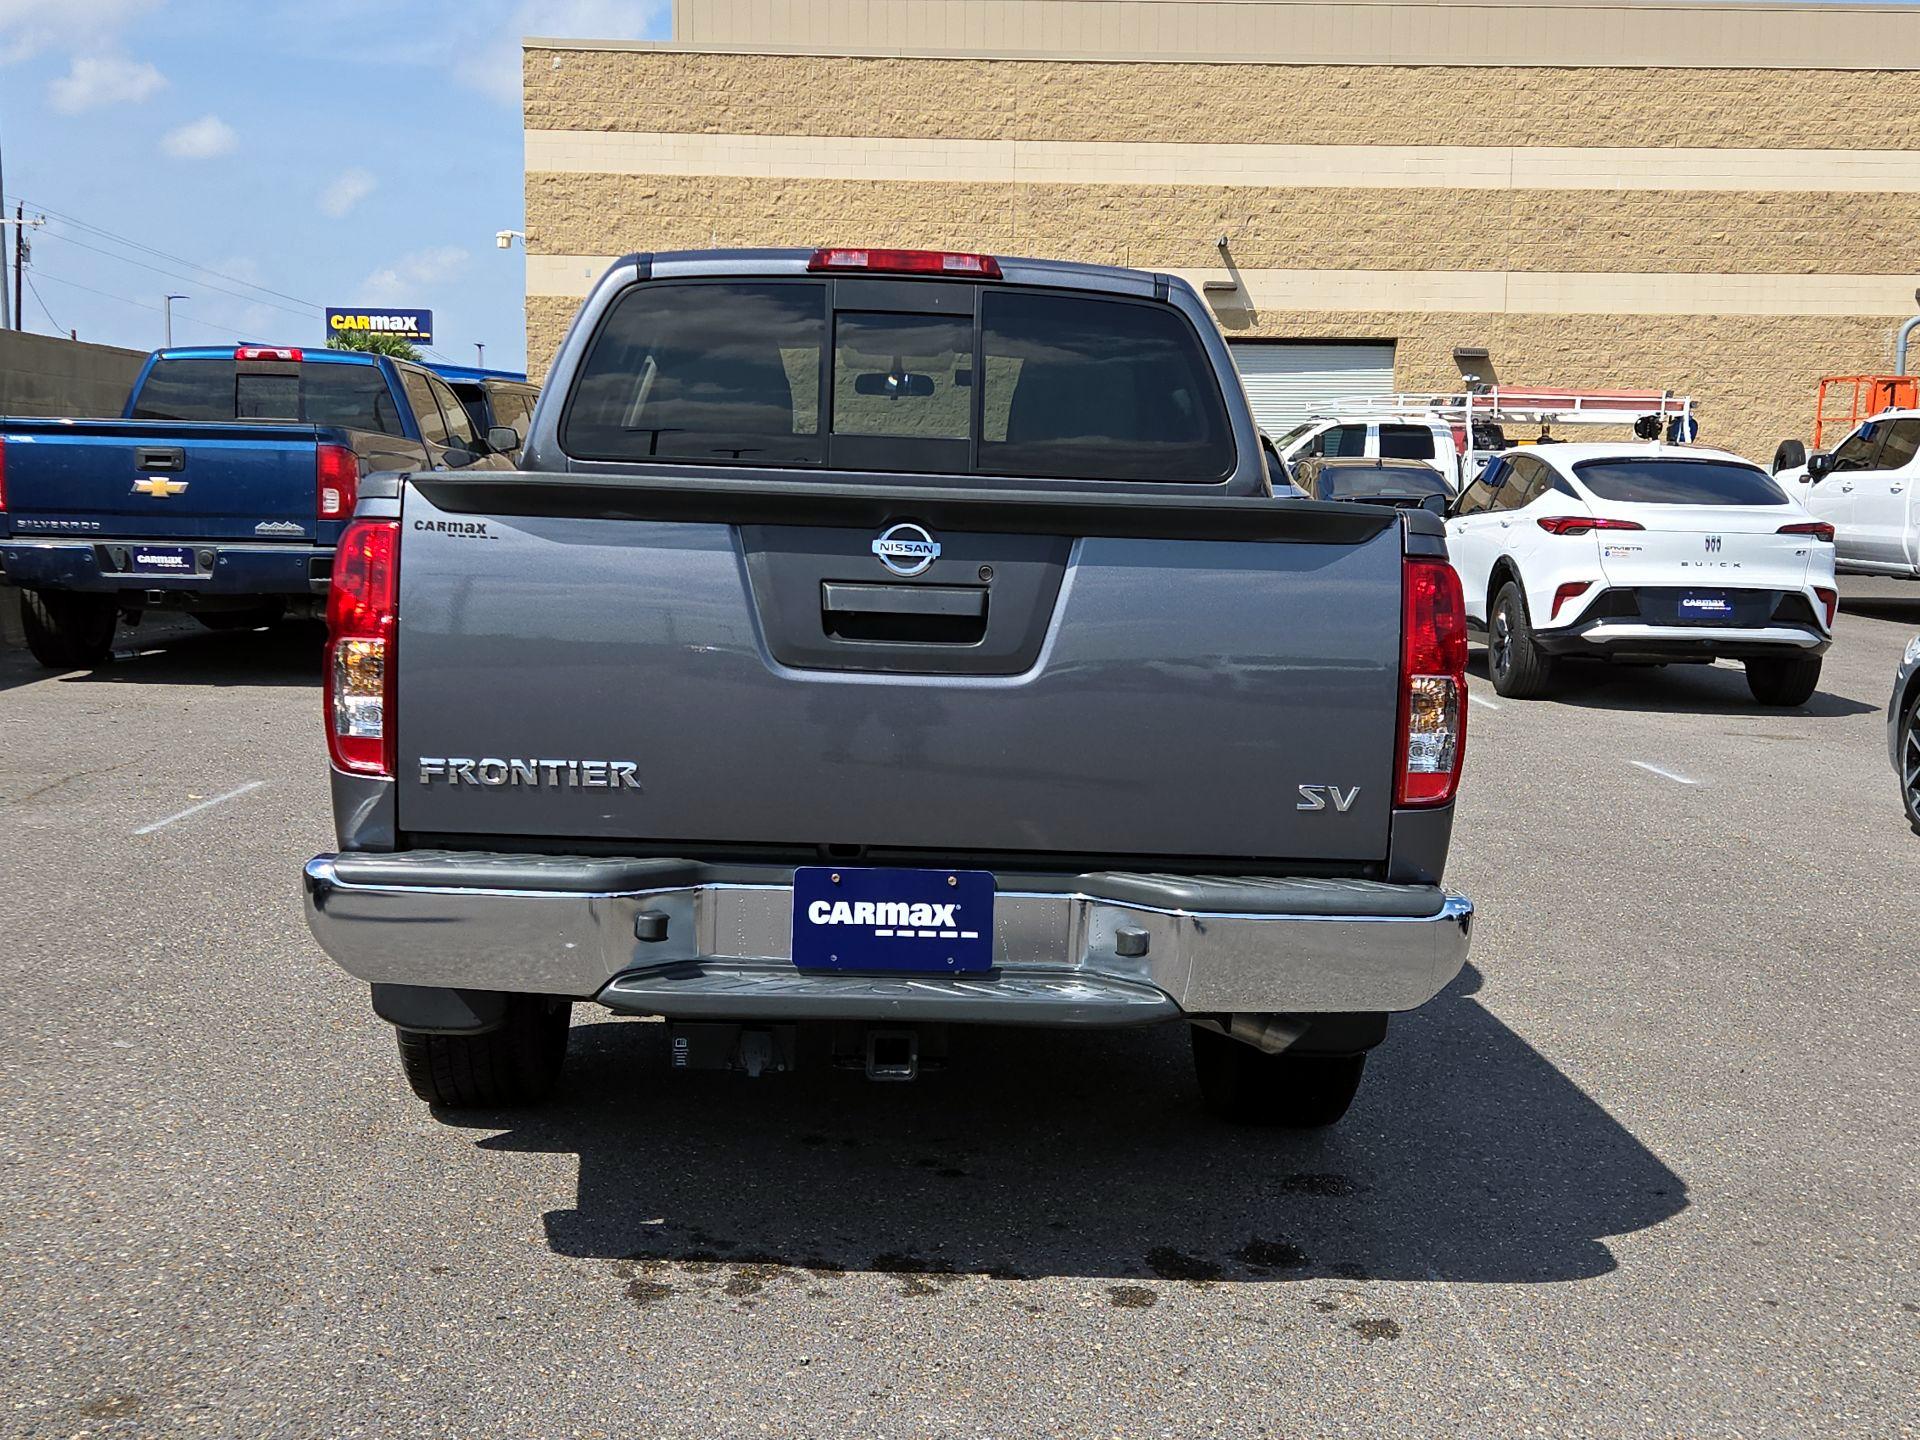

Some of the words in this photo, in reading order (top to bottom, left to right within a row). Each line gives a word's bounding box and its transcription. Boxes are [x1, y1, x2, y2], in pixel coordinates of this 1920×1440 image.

[880, 543, 934, 553] NISSAN
[419, 757, 642, 788] FRONTIER
[1296, 784, 1361, 812] SV
